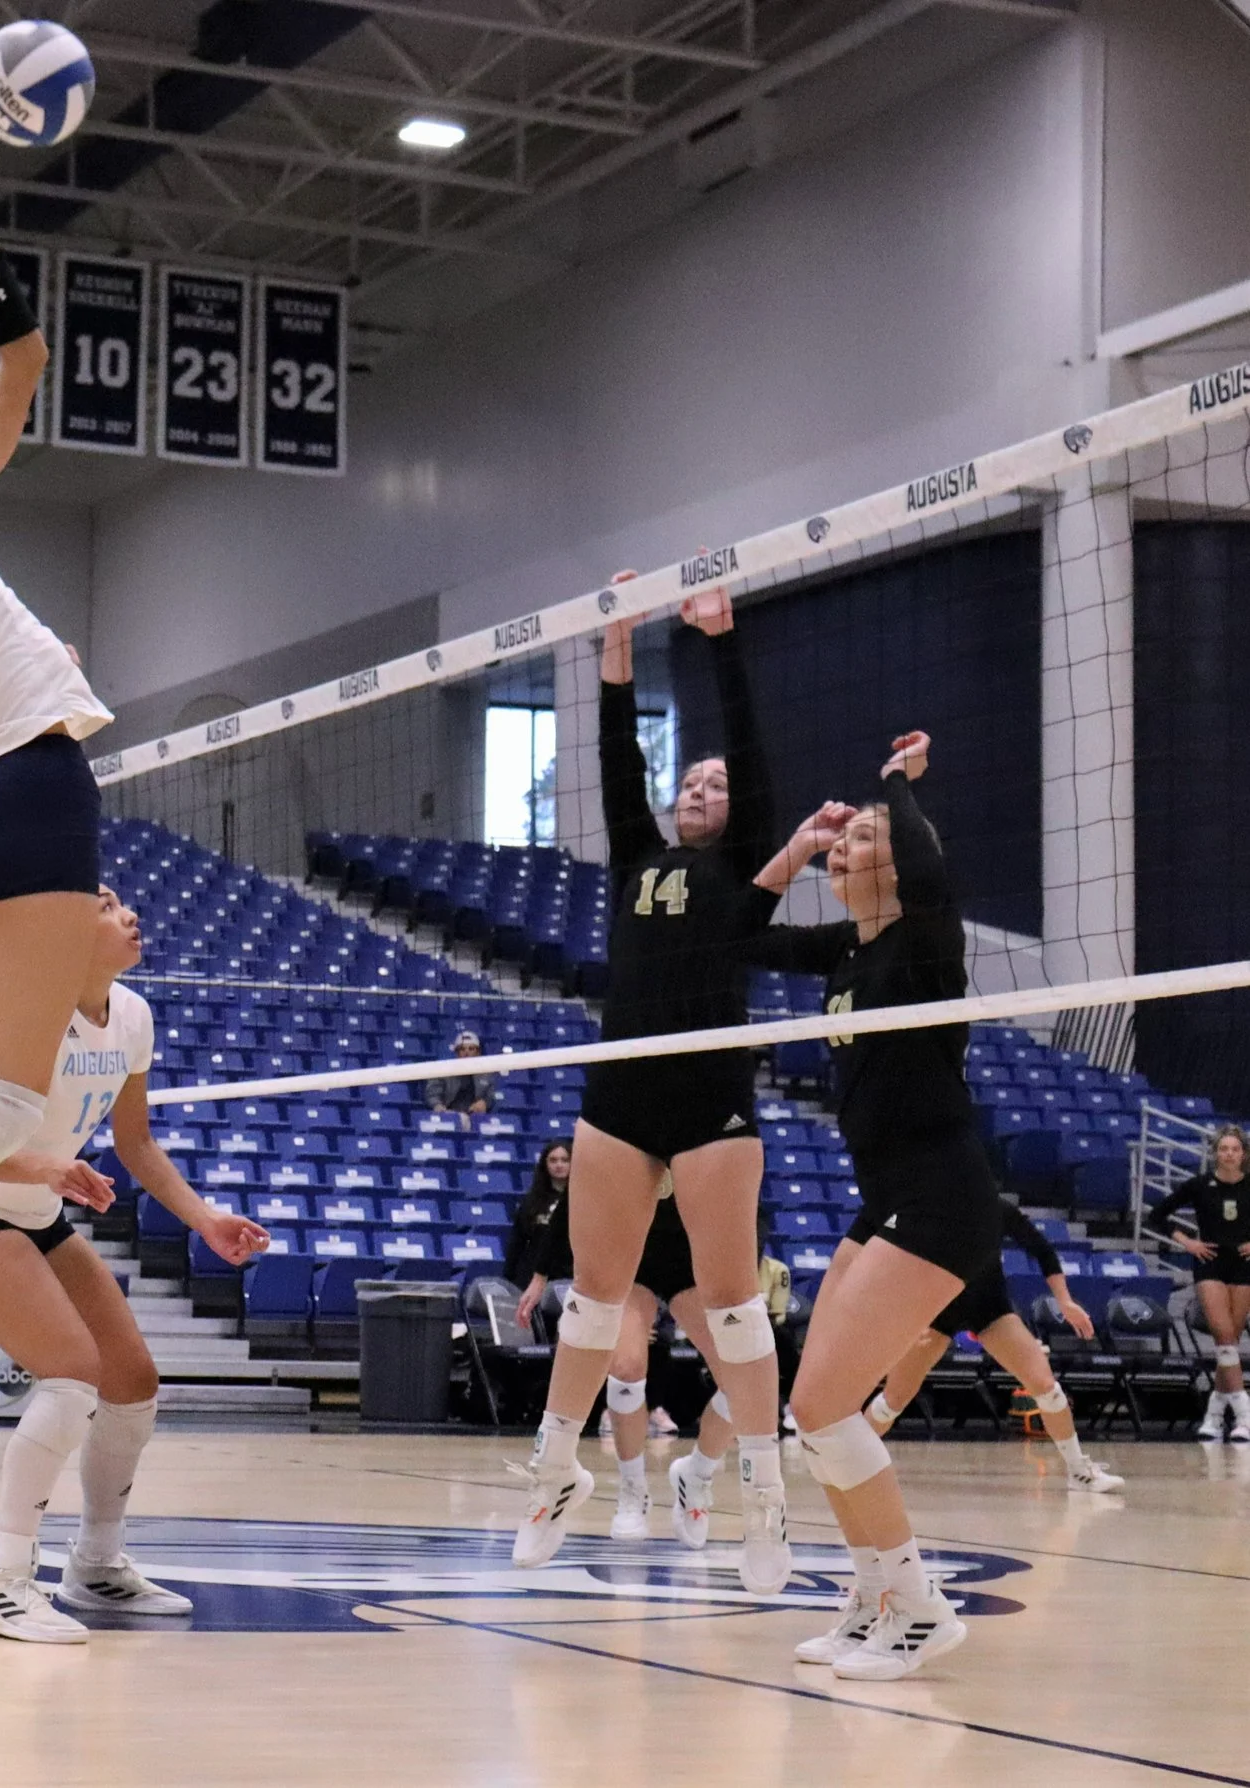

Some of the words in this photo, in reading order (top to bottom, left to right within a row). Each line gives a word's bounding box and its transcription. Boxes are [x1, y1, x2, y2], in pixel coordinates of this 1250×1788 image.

[75, 334, 130, 388] 10
[171, 346, 238, 402] 23
[271, 359, 335, 413] 32
[906, 463, 977, 513] AUGUSTA
[680, 546, 739, 590] AUGUSTA
[494, 615, 543, 652] AUGUSTA
[339, 669, 380, 702] AUGUSTA
[206, 716, 241, 745] AUGUSTA
[634, 868, 689, 915] 14
[62, 1051, 128, 1076] AUGUSTA
